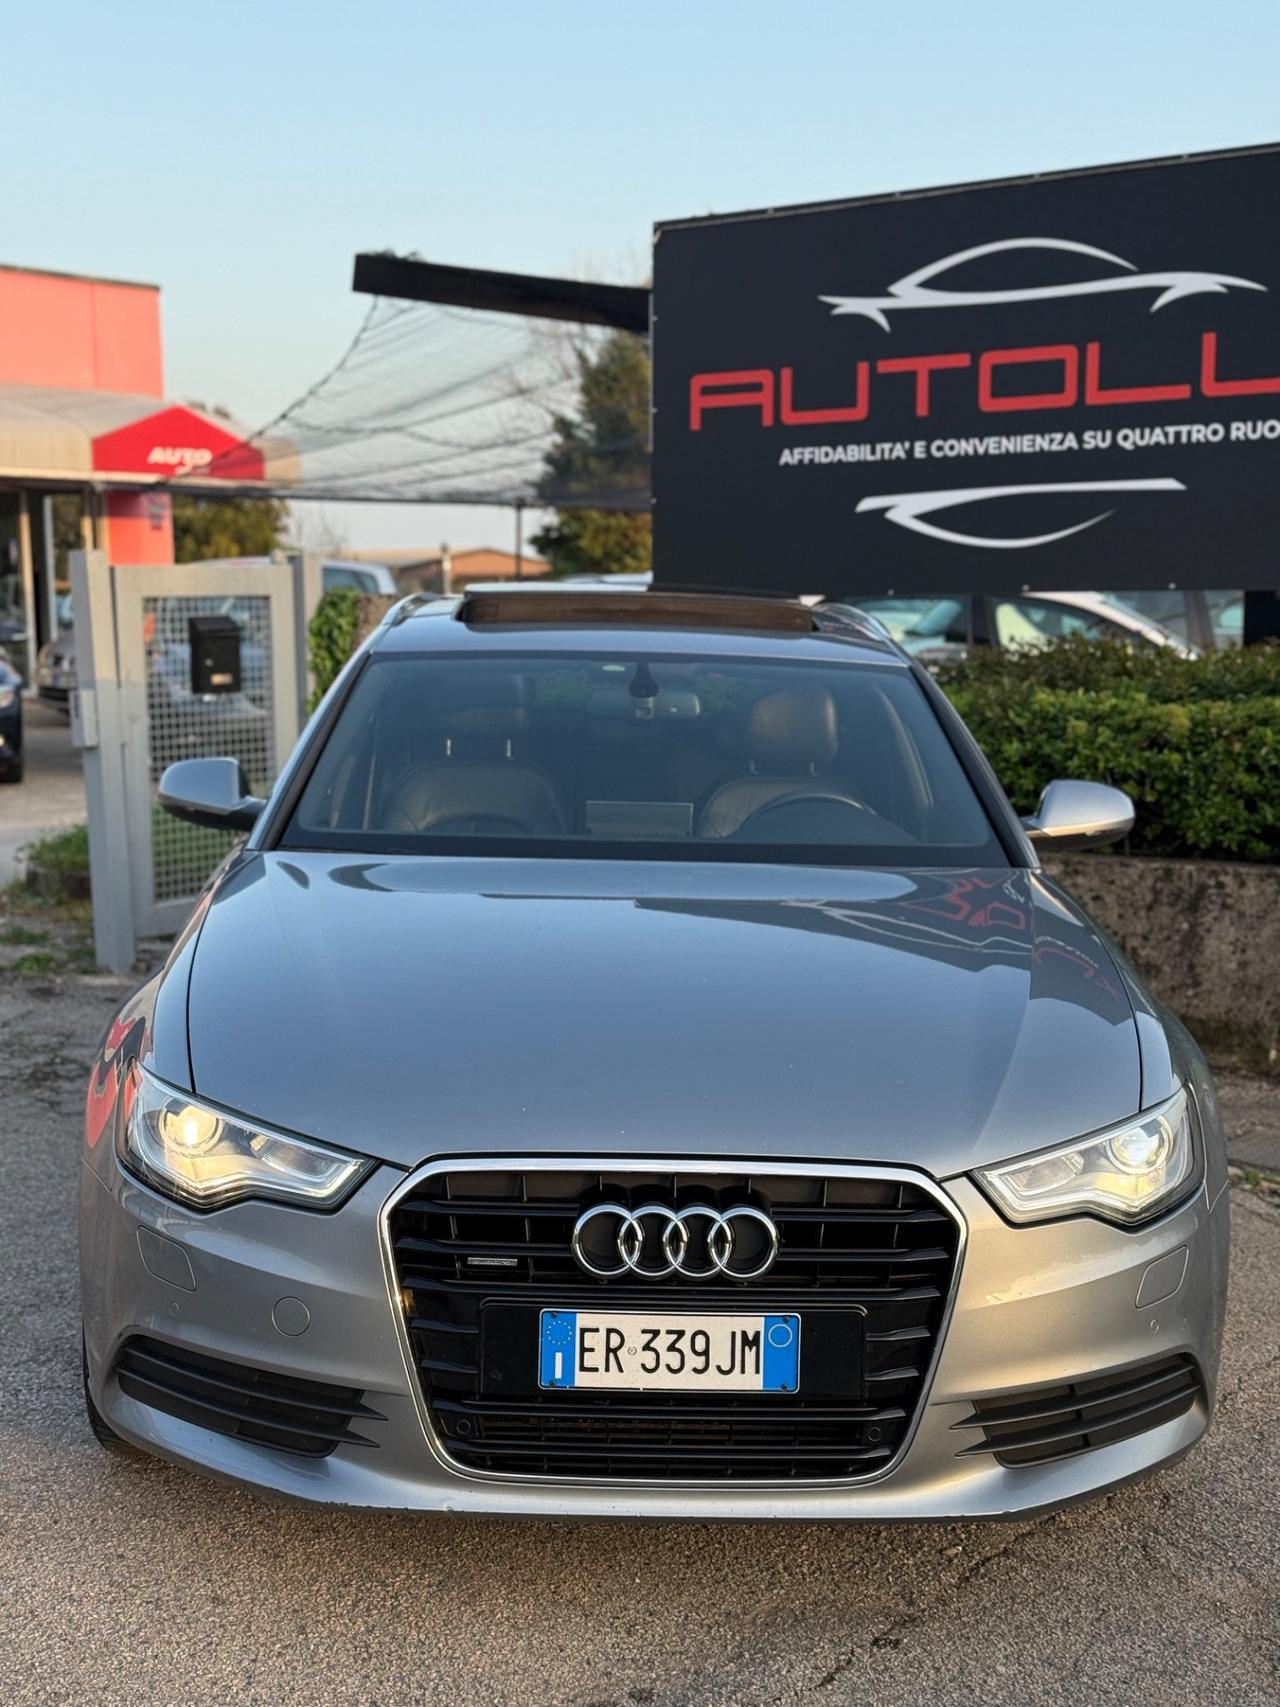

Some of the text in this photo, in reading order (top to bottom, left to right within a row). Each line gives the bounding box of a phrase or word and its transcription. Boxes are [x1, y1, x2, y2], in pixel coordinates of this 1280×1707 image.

[146, 446, 213, 467] AUTO
[779, 442, 911, 466] AFFIDABILITA'
[914, 440, 927, 458] E
[931, 432, 1078, 459] CONVENIENZA
[1083, 429, 1111, 450] SU
[1116, 422, 1225, 450] QUATTRO
[578, 1327, 626, 1373] ER
